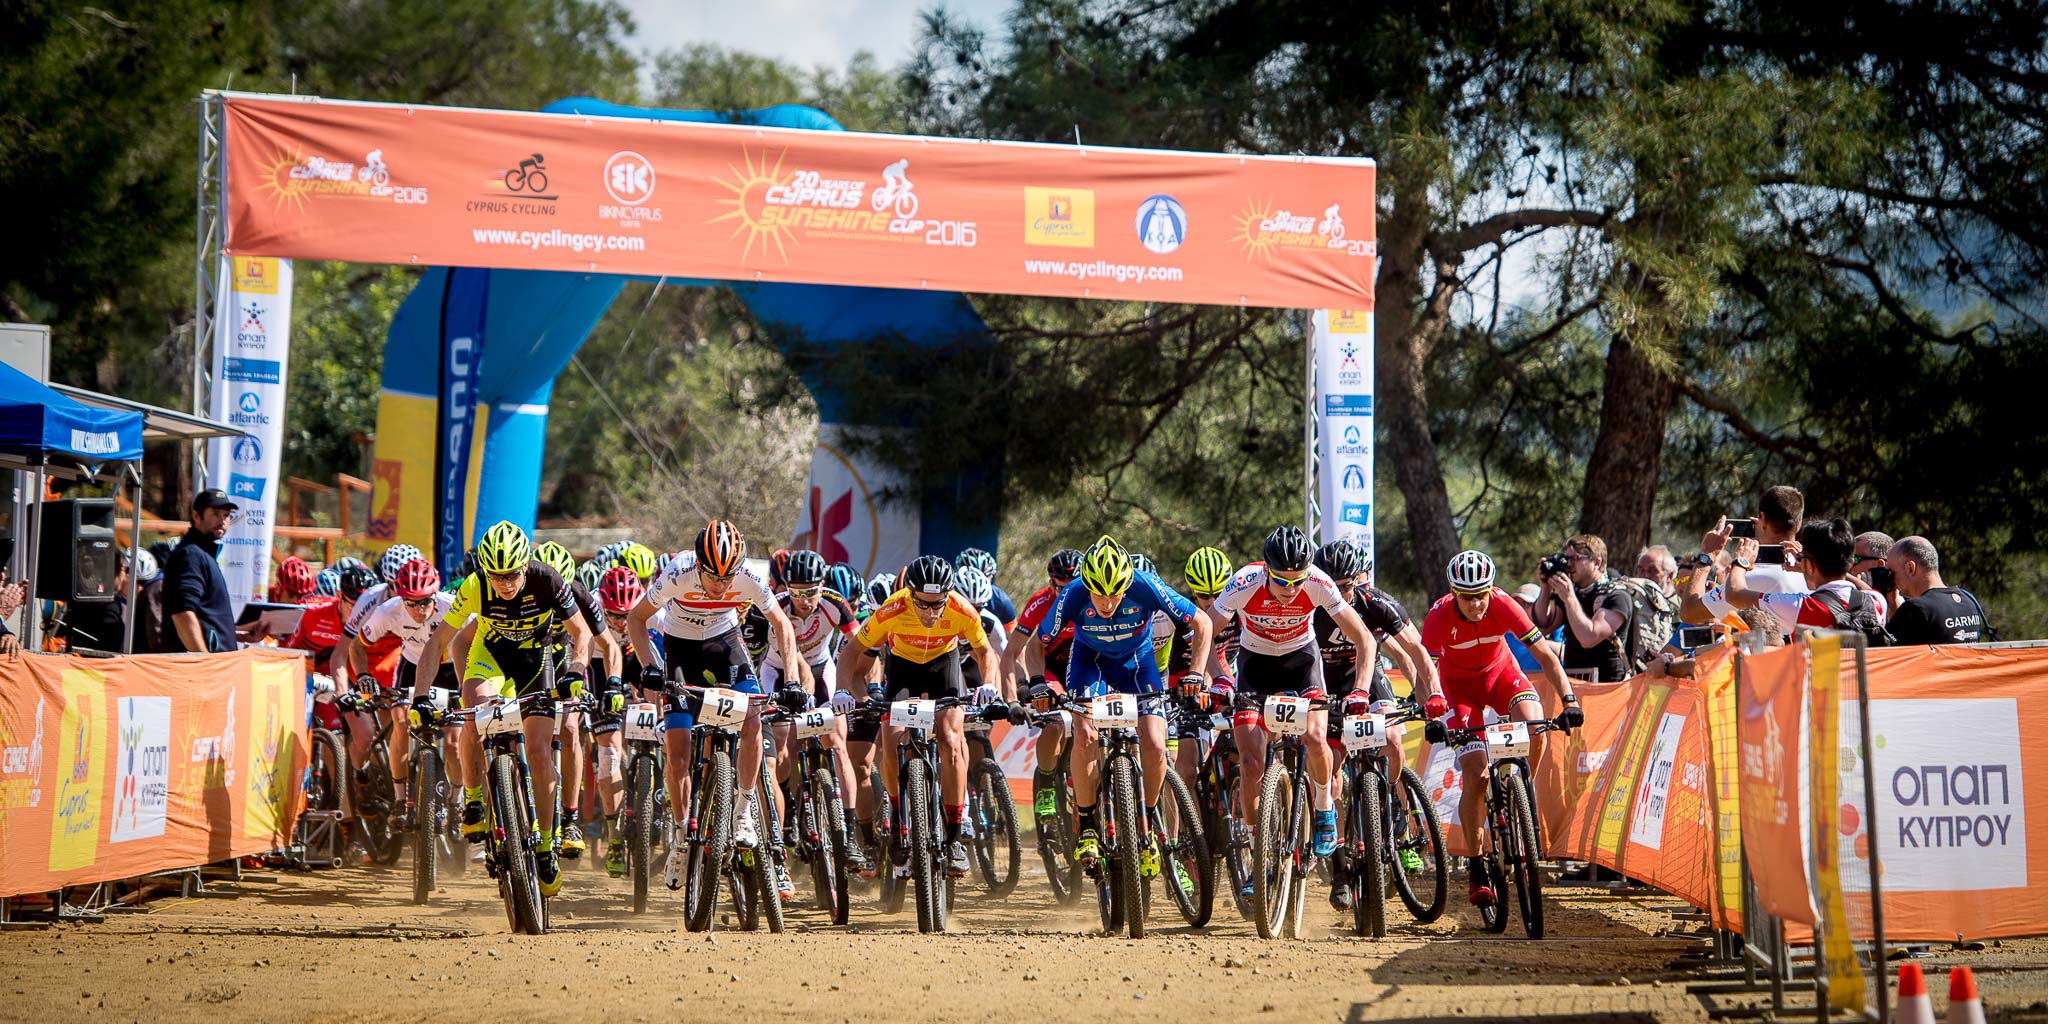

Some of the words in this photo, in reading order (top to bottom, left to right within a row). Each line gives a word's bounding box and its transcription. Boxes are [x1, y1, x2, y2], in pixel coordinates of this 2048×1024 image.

[289, 166, 353, 181] CYPRUS
[792, 171, 819, 188] 20
[819, 179, 850, 190] YEARS
[850, 181, 866, 191] OF
[287, 179, 370, 194] SUNSHINE
[394, 186, 428, 204] 2016
[765, 186, 863, 208] CYPRUS
[466, 201, 508, 213] CYPRUS
[511, 203, 556, 215] CYCLING
[758, 206, 891, 232] SUNSHINE
[1033, 218, 1073, 232] Cyprus
[1259, 219, 1315, 234] CYPRUS
[473, 229, 645, 252] www.cyclingcy.com
[888, 218, 925, 234] CUP
[925, 220, 977, 248] 2016
[1256, 232, 1330, 248] SUNSHINE
[1025, 260, 1183, 283] www.cyclingcy.com
[228, 413, 269, 425] atlantic
[1336, 445, 1369, 455] atlantic
[247, 518, 265, 526] CNA
[1050, 588, 1070, 637] CASTELLI
[1081, 620, 1145, 632] CASTELLI
[312, 630, 341, 640] FOC
[492, 706, 504, 721] 4
[717, 697, 734, 718] 12
[907, 703, 918, 716] 5
[1105, 701, 1124, 716] 16
[1275, 703, 1297, 723] 92
[636, 712, 655, 730] 44
[806, 712, 824, 728] 43
[1354, 720, 1375, 738] 30
[1503, 733, 1515, 747] 2
[1899, 814, 2012, 848] ΚΥΠΡΟΥ
